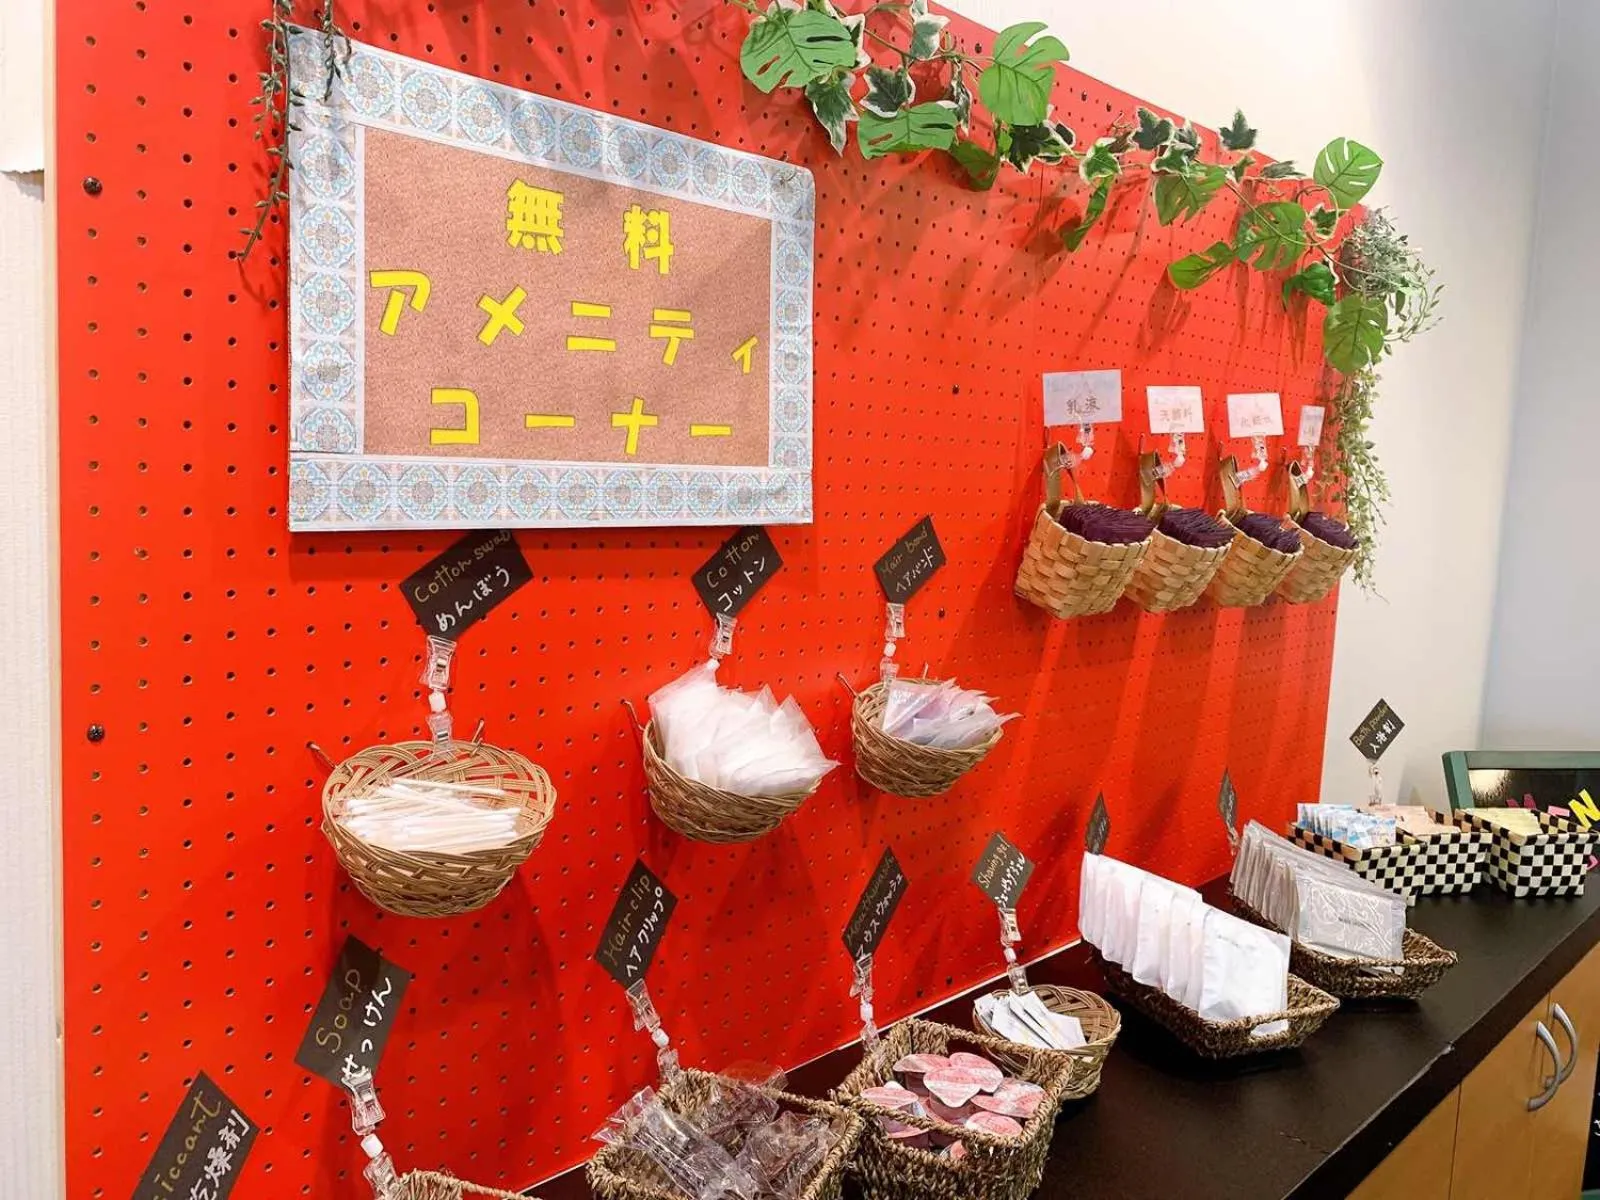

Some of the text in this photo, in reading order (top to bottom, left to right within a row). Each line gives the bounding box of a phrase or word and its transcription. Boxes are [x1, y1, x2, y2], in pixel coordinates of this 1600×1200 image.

[506, 179, 674, 275] 無料
[369, 269, 758, 374] アメニティ
[430, 386, 732, 455] コーナー
[414, 559, 472, 603] Cotton
[435, 565, 510, 632] めんぼう
[706, 534, 759, 589] Cotton
[717, 556, 765, 612] コットン
[625, 886, 664, 978] ヘアクリップ
[315, 968, 363, 1054] Soap
[341, 976, 392, 1080] せっけん
